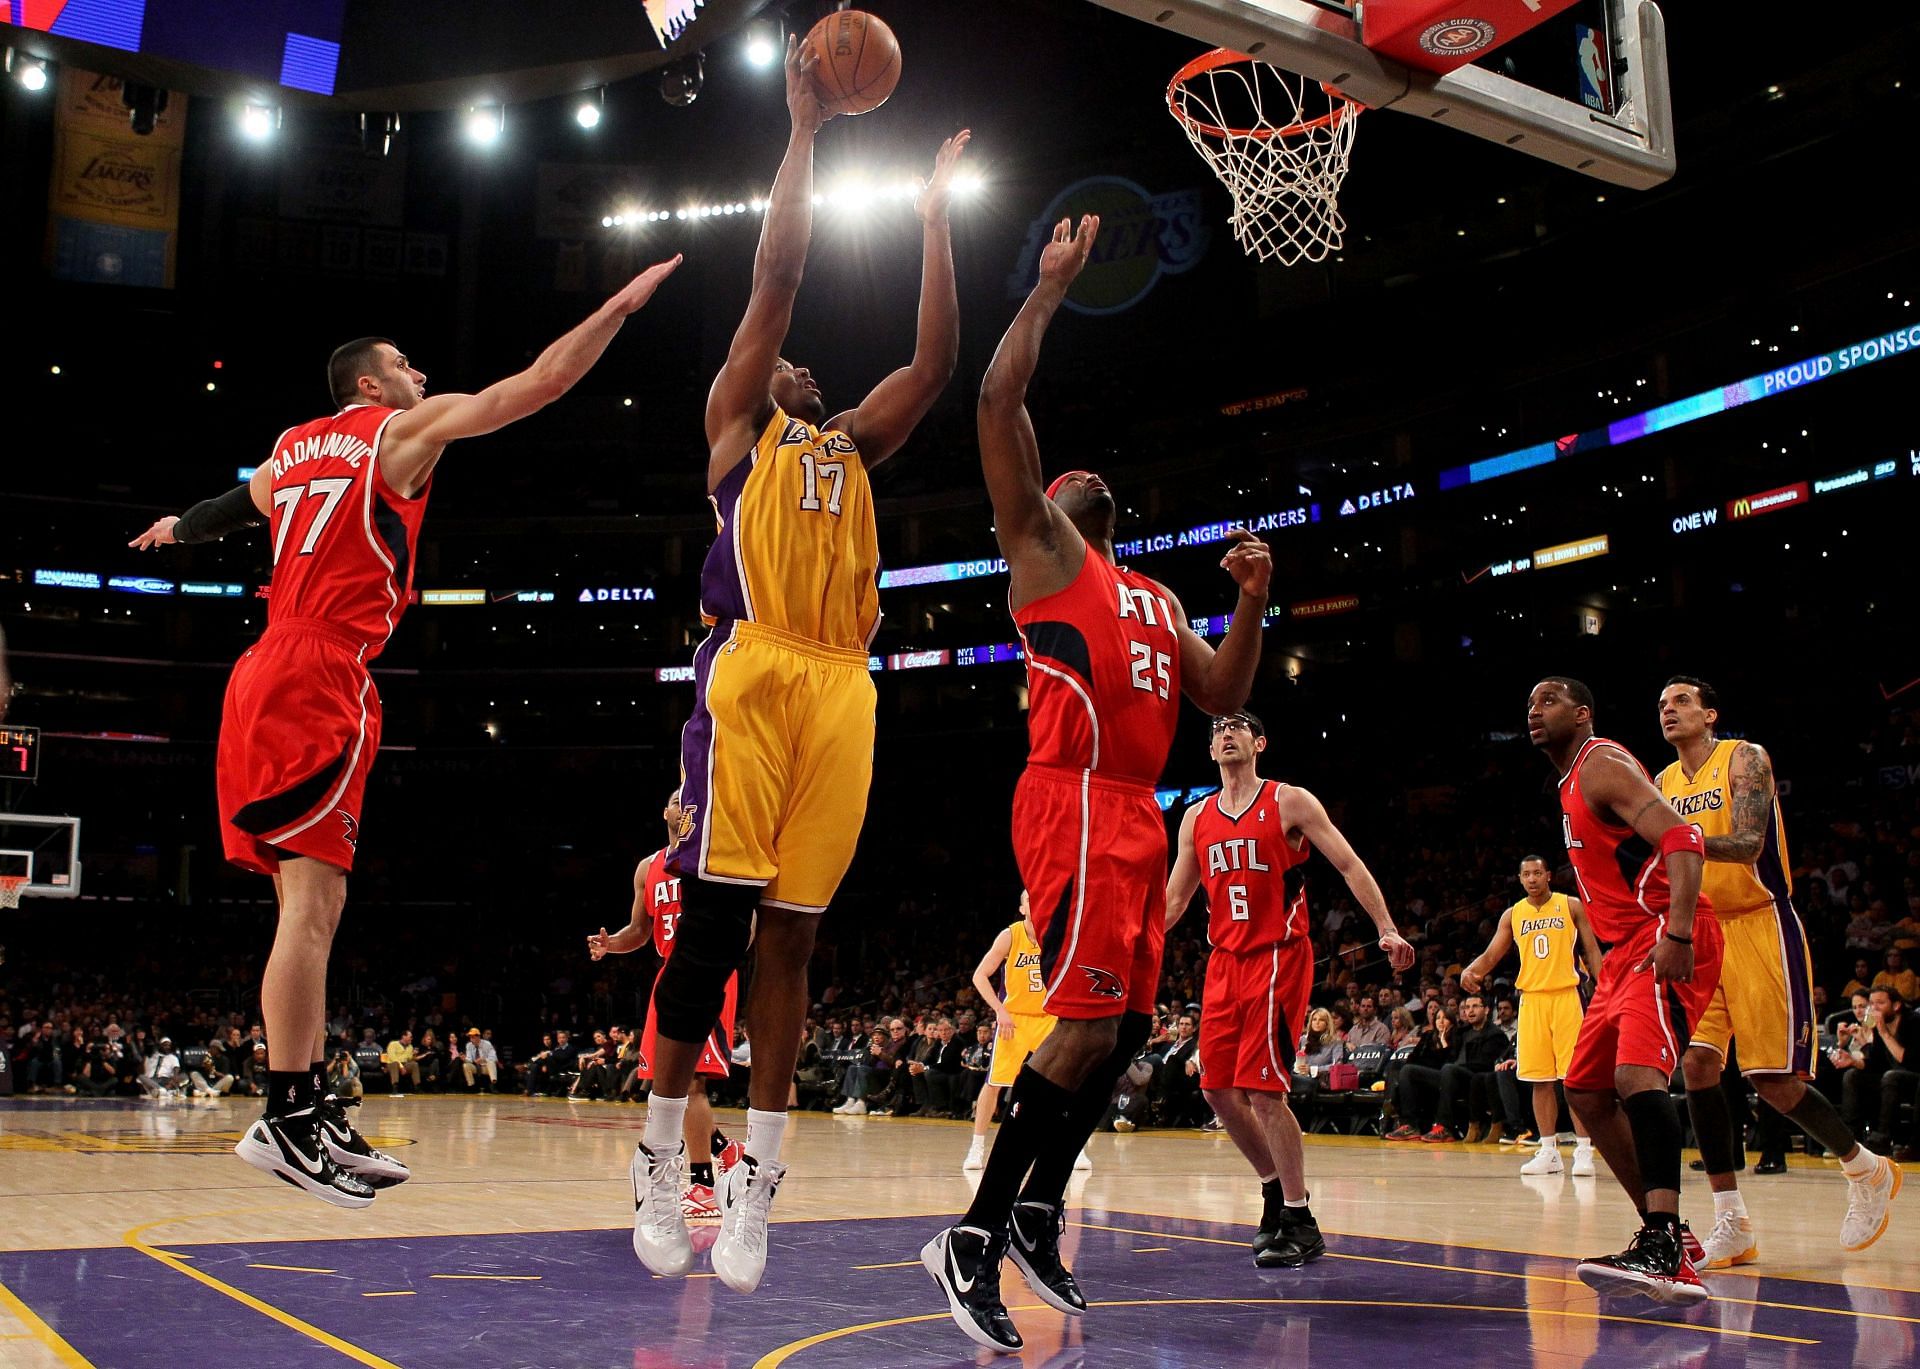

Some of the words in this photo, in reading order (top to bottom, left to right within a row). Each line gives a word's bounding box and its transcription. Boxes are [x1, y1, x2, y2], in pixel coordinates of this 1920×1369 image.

[1450, 18, 1474, 26] CLUB
[1440, 28, 1473, 46] AAA
[1584, 92, 1604, 112] NBA
[81, 158, 154, 191] LAKERS
[1763, 356, 1832, 393] PROUD
[800, 452, 846, 518] 17
[1814, 469, 1869, 494] Panasonic
[1358, 482, 1415, 511] DELTA
[273, 479, 353, 567] 77
[1115, 539, 1143, 559] THE
[1147, 533, 1173, 553] LOS
[1178, 520, 1243, 547] ANGELES
[1248, 508, 1306, 533] LAKERS
[1672, 511, 1701, 534] ONE
[1535, 552, 1553, 565] THE
[1554, 547, 1578, 562] HOME
[1579, 541, 1606, 556] DEPOT
[957, 559, 1009, 577] PROUD
[597, 588, 655, 601] DELTA
[1290, 603, 1325, 617] WELLS
[1326, 598, 1360, 611] FARGO
[1192, 618, 1209, 629] TOR
[1224, 614, 1229, 624] 1
[1224, 625, 1230, 634] 3
[957, 648, 974, 657] NYI
[989, 645, 995, 654] 3
[957, 656, 975, 666] WIN
[989, 654, 995, 663] 1
[1130, 640, 1171, 701] 25
[13, 746, 28, 772] 7
[1208, 838, 1270, 878] ATL
[655, 878, 682, 909] AT
[1228, 884, 1250, 922] 6
[662, 911, 682, 942] 3
[1520, 917, 1565, 937] LAKERS
[1533, 933, 1550, 960] 0
[1028, 968, 1044, 993] 5
[1356, 1051, 1381, 1060] DELTA
